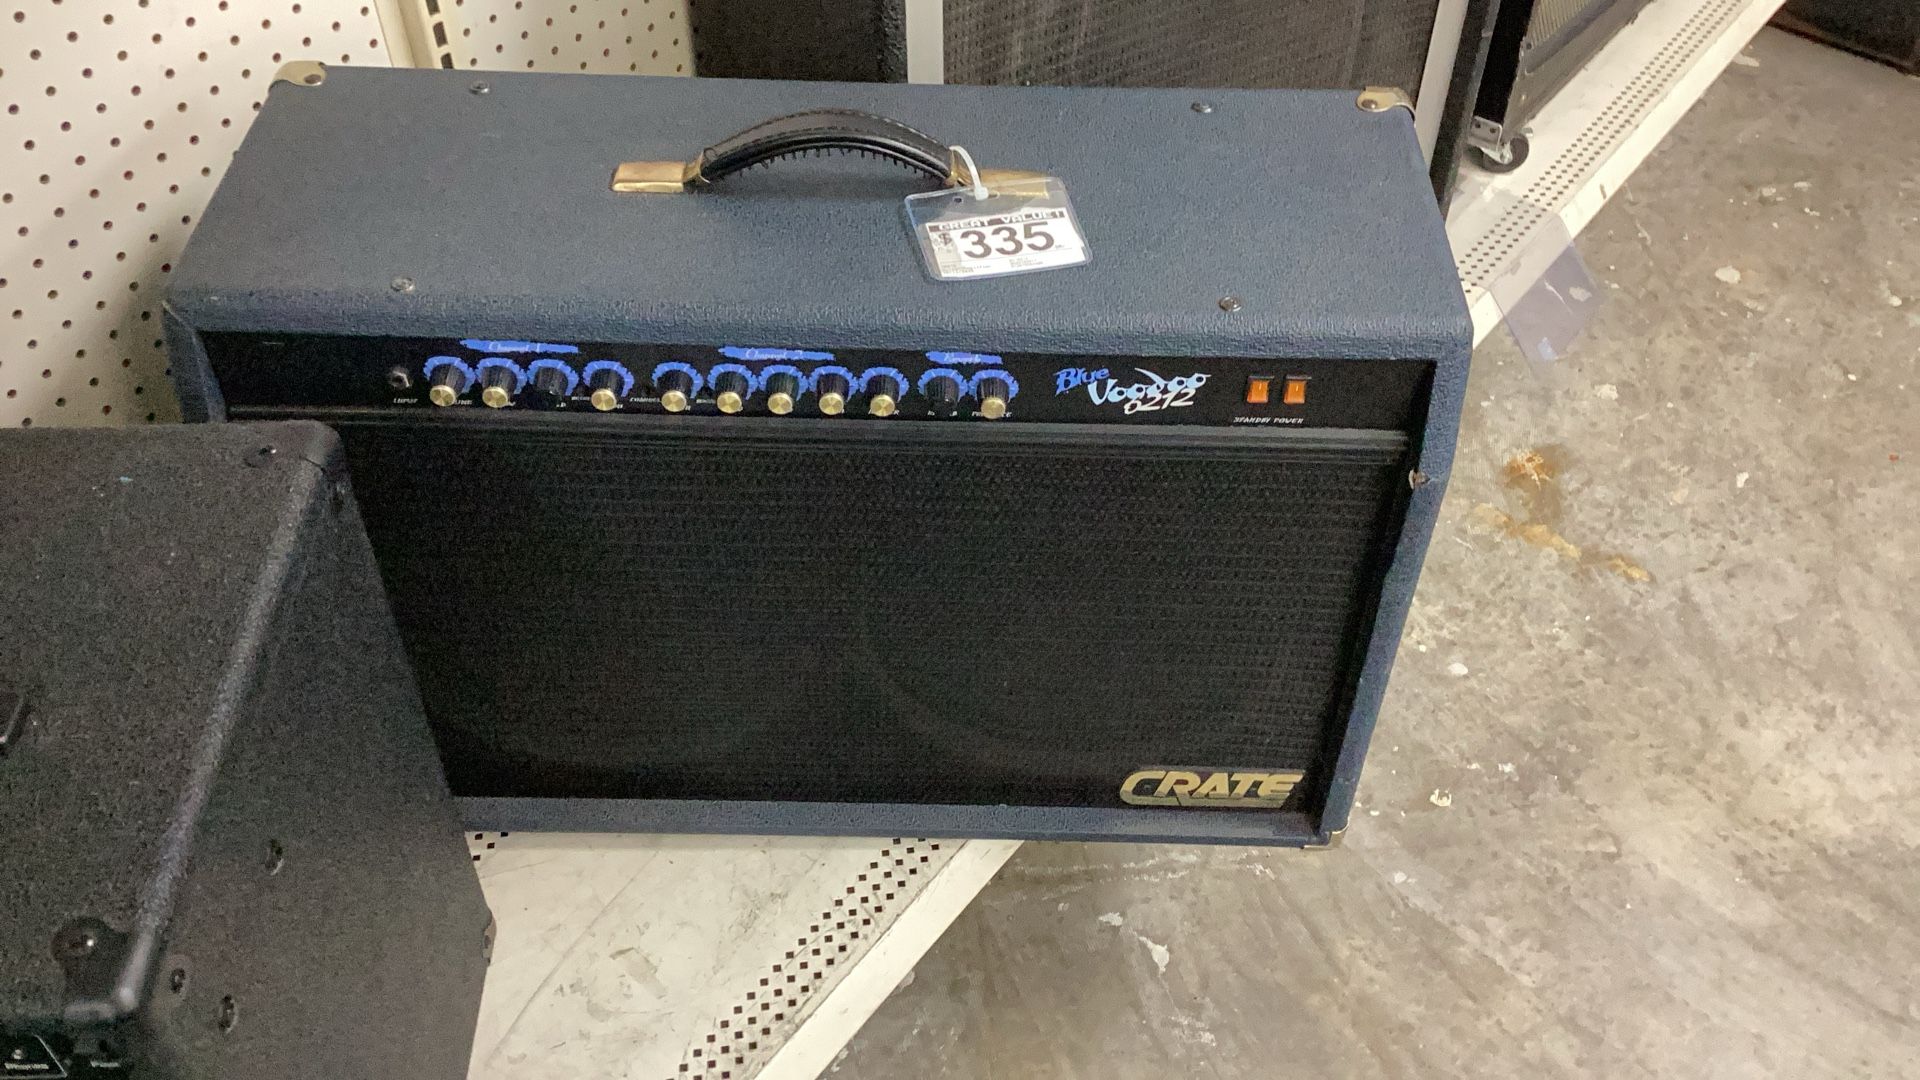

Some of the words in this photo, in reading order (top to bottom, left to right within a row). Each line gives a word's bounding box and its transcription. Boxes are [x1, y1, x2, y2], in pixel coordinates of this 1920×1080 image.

[939, 217, 991, 231] GREAT
[1053, 367, 1110, 397] Blue
[1087, 367, 1212, 406] Voodoo
[1233, 416, 1272, 424] STANDBY
[1273, 416, 1304, 424] POWER
[1119, 770, 1304, 809] CRATE
